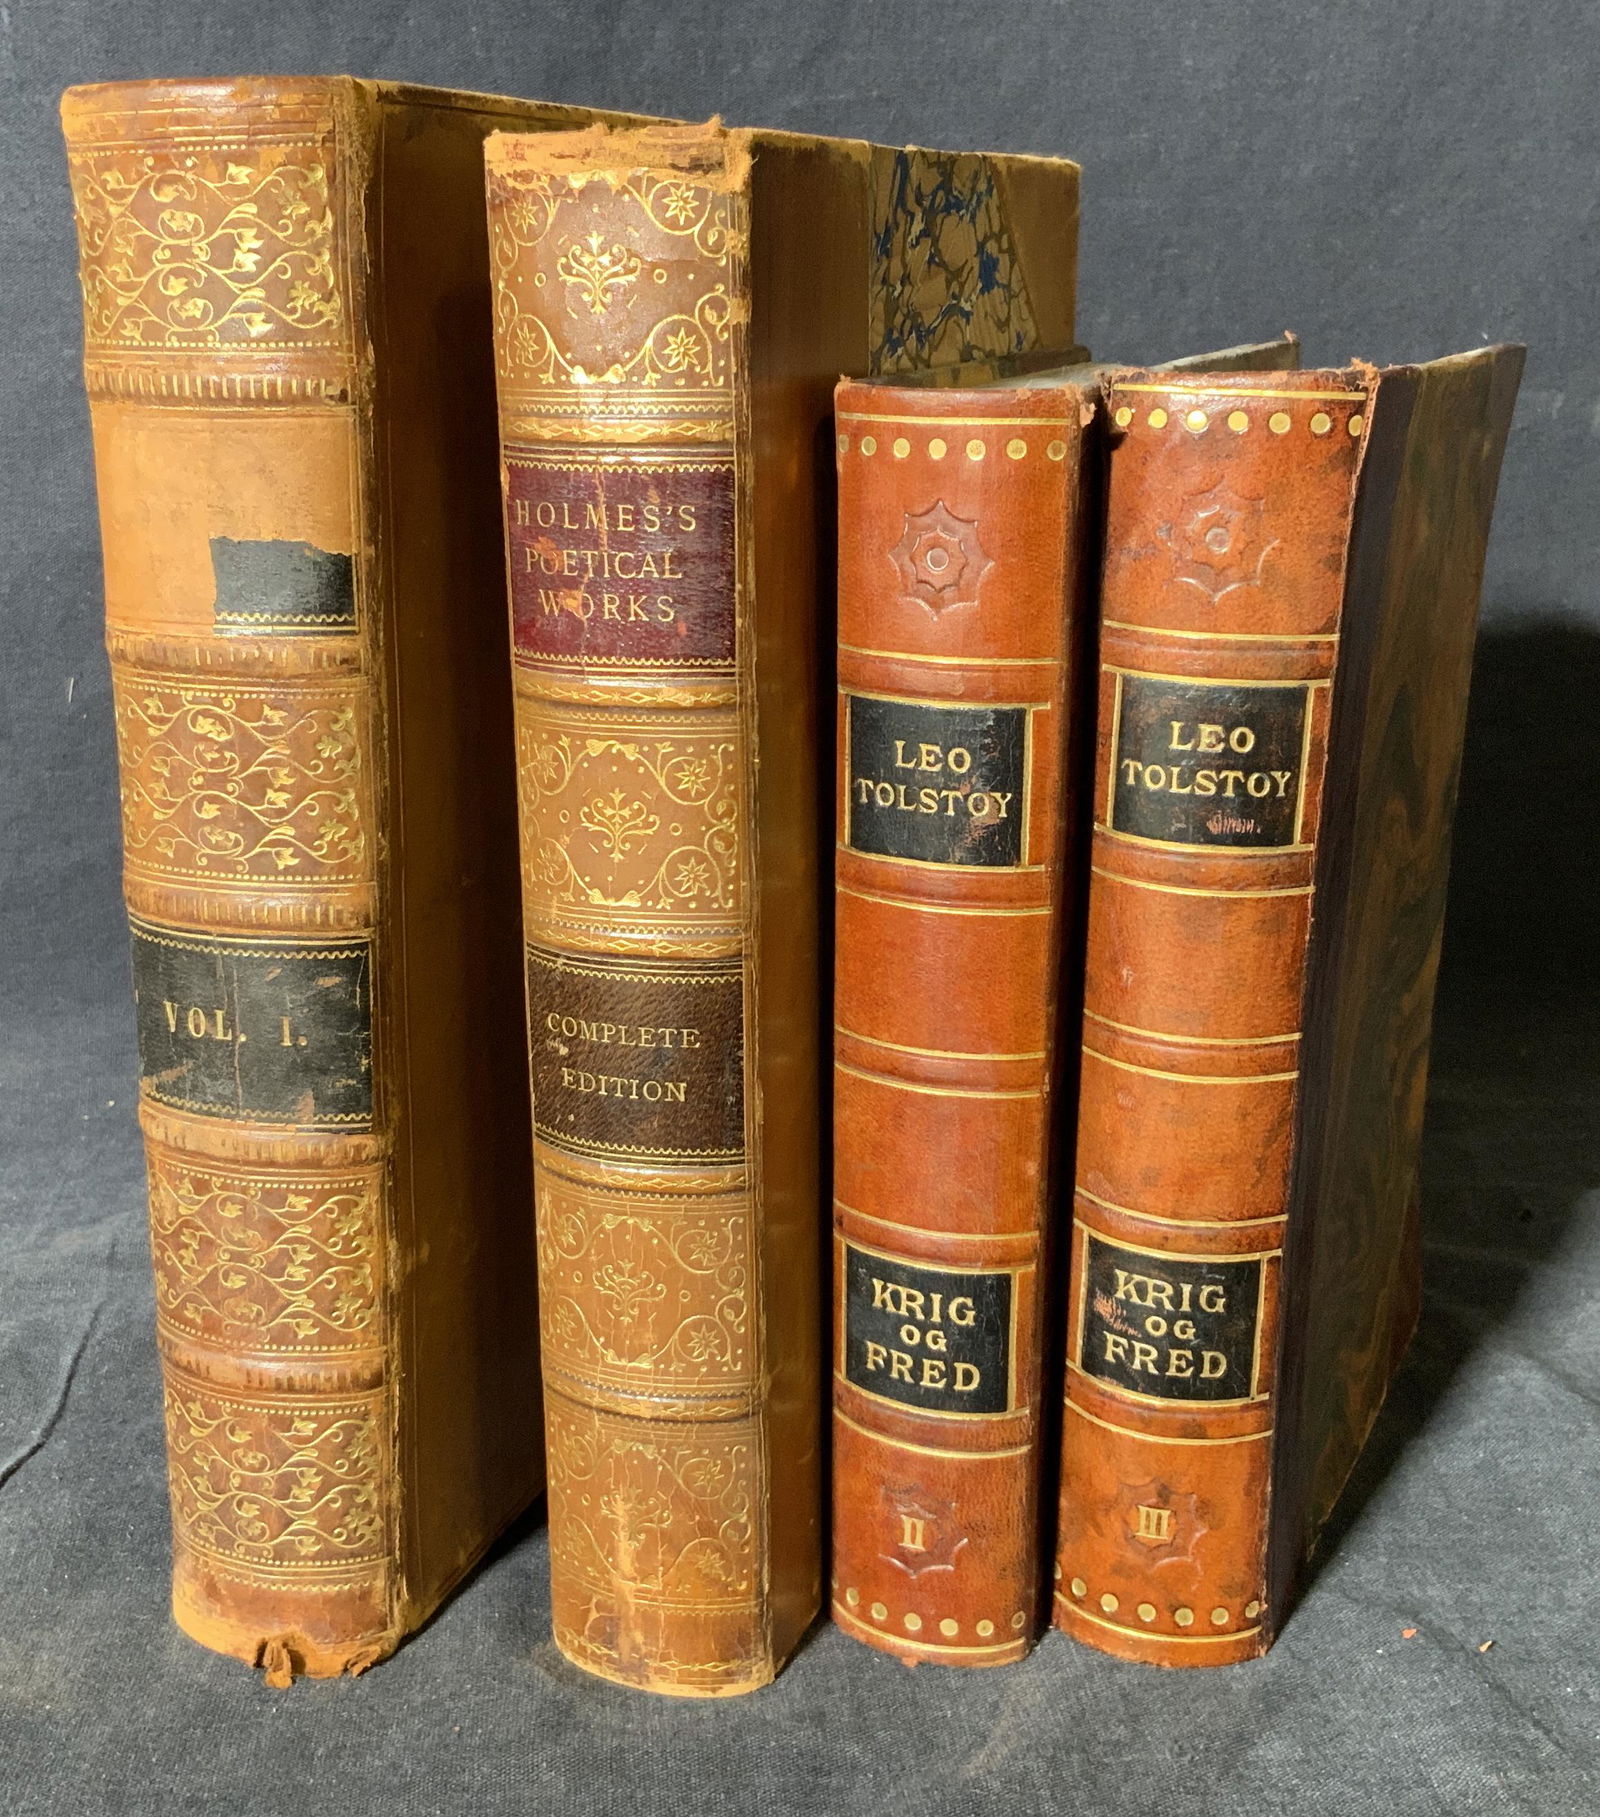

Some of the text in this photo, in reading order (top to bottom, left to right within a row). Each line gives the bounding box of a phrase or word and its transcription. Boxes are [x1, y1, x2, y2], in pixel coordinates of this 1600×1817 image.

[515, 499, 697, 532] HOLMES'S
[525, 547, 684, 579] POETICAL
[538, 588, 676, 622] WORKS
[1168, 721, 1255, 754] LEO
[894, 740, 972, 774] LEO
[1120, 758, 1292, 798] TOLSTOY
[856, 778, 1012, 818] TOLSTOY
[162, 1000, 247, 1042] VOL.
[547, 1012, 701, 1049] COMPLETE
[561, 1067, 688, 1102] EDITION
[871, 1278, 977, 1327] KRIG
[1113, 1268, 1227, 1313] KRIG
[899, 1323, 948, 1352] OG
[1145, 1315, 1197, 1340] OG
[865, 1340, 981, 1392] FRED
[1102, 1330, 1228, 1379] FRED
[898, 1514, 926, 1551] II
[1134, 1504, 1172, 1541] III
